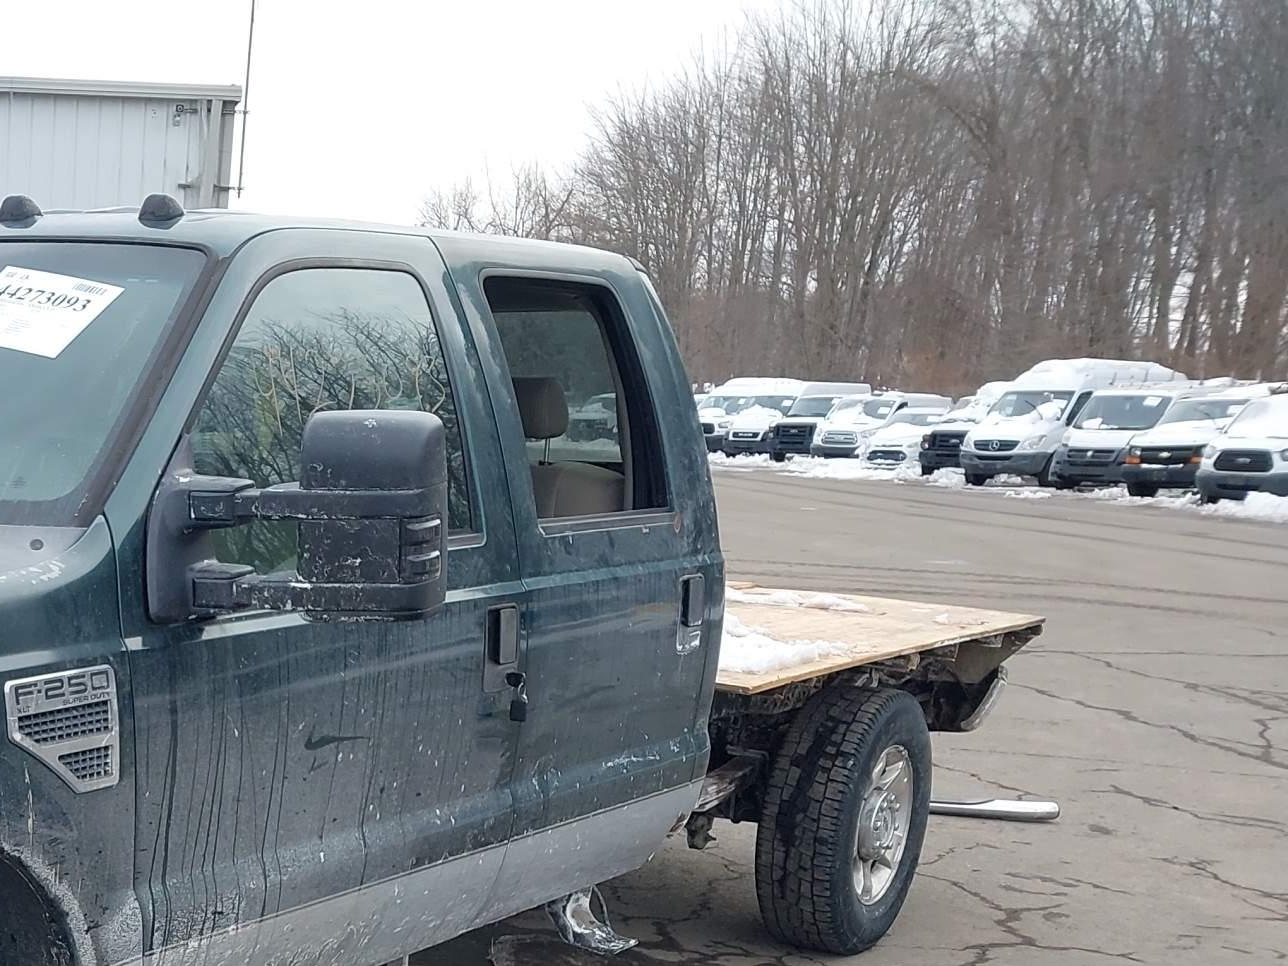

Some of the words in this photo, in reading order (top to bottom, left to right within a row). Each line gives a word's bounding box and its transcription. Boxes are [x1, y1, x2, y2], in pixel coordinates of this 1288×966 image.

[15, 670, 110, 705] F-250
[62, 695, 89, 706] SUPER
[90, 692, 110, 701] DUTY
[16, 706, 31, 714] XLT
